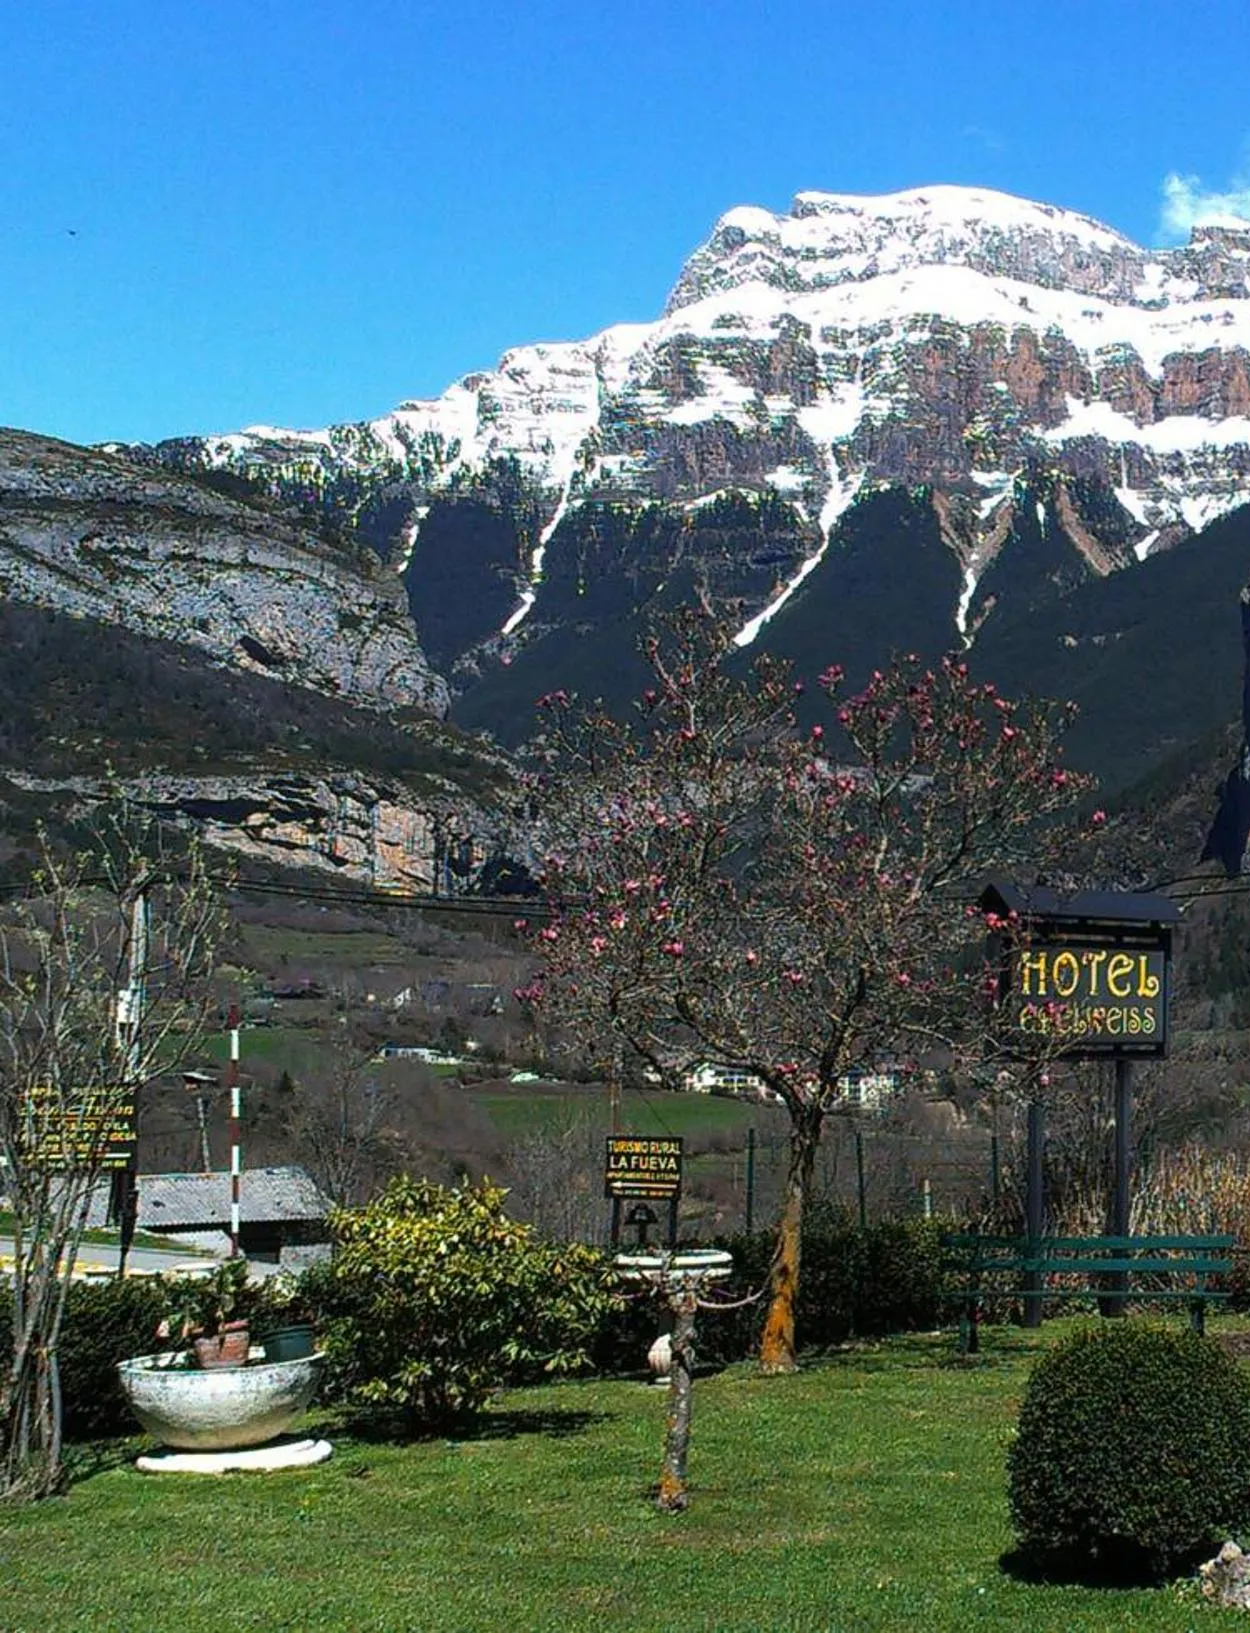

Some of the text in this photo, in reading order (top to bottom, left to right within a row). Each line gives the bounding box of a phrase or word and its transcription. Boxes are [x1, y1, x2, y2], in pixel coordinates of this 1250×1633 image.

[1019, 950, 1160, 997] HOTEL
[609, 1155, 677, 1170] LA FUEVA
